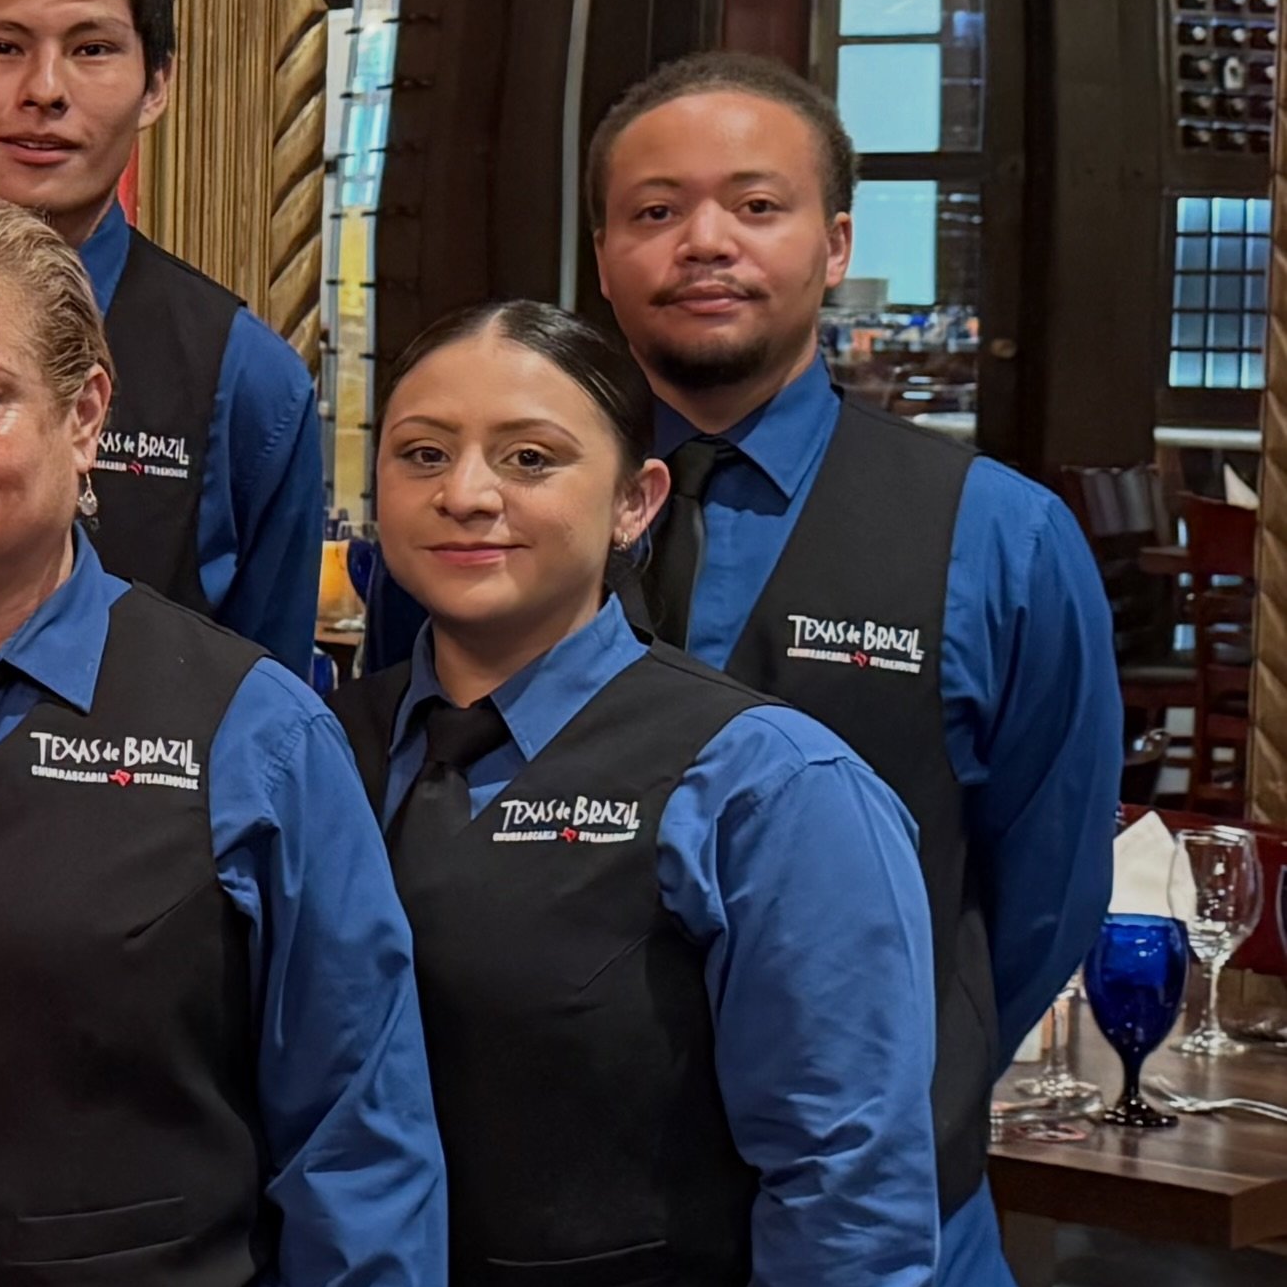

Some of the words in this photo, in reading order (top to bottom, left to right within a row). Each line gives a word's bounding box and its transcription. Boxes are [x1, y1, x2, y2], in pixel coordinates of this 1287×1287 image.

[123, 435, 135, 453] de
[137, 431, 189, 465] BRAZIL
[787, 615, 847, 647] TEXAS
[846, 624, 861, 644] de
[863, 621, 925, 661] BRAZIL
[30, 732, 102, 765] TEXAS
[102, 742, 120, 761] de
[124, 737, 200, 776] BRAZIL
[500, 799, 557, 831] TEXAS
[555, 801, 571, 820] de
[573, 796, 640, 830] BRAZIL
